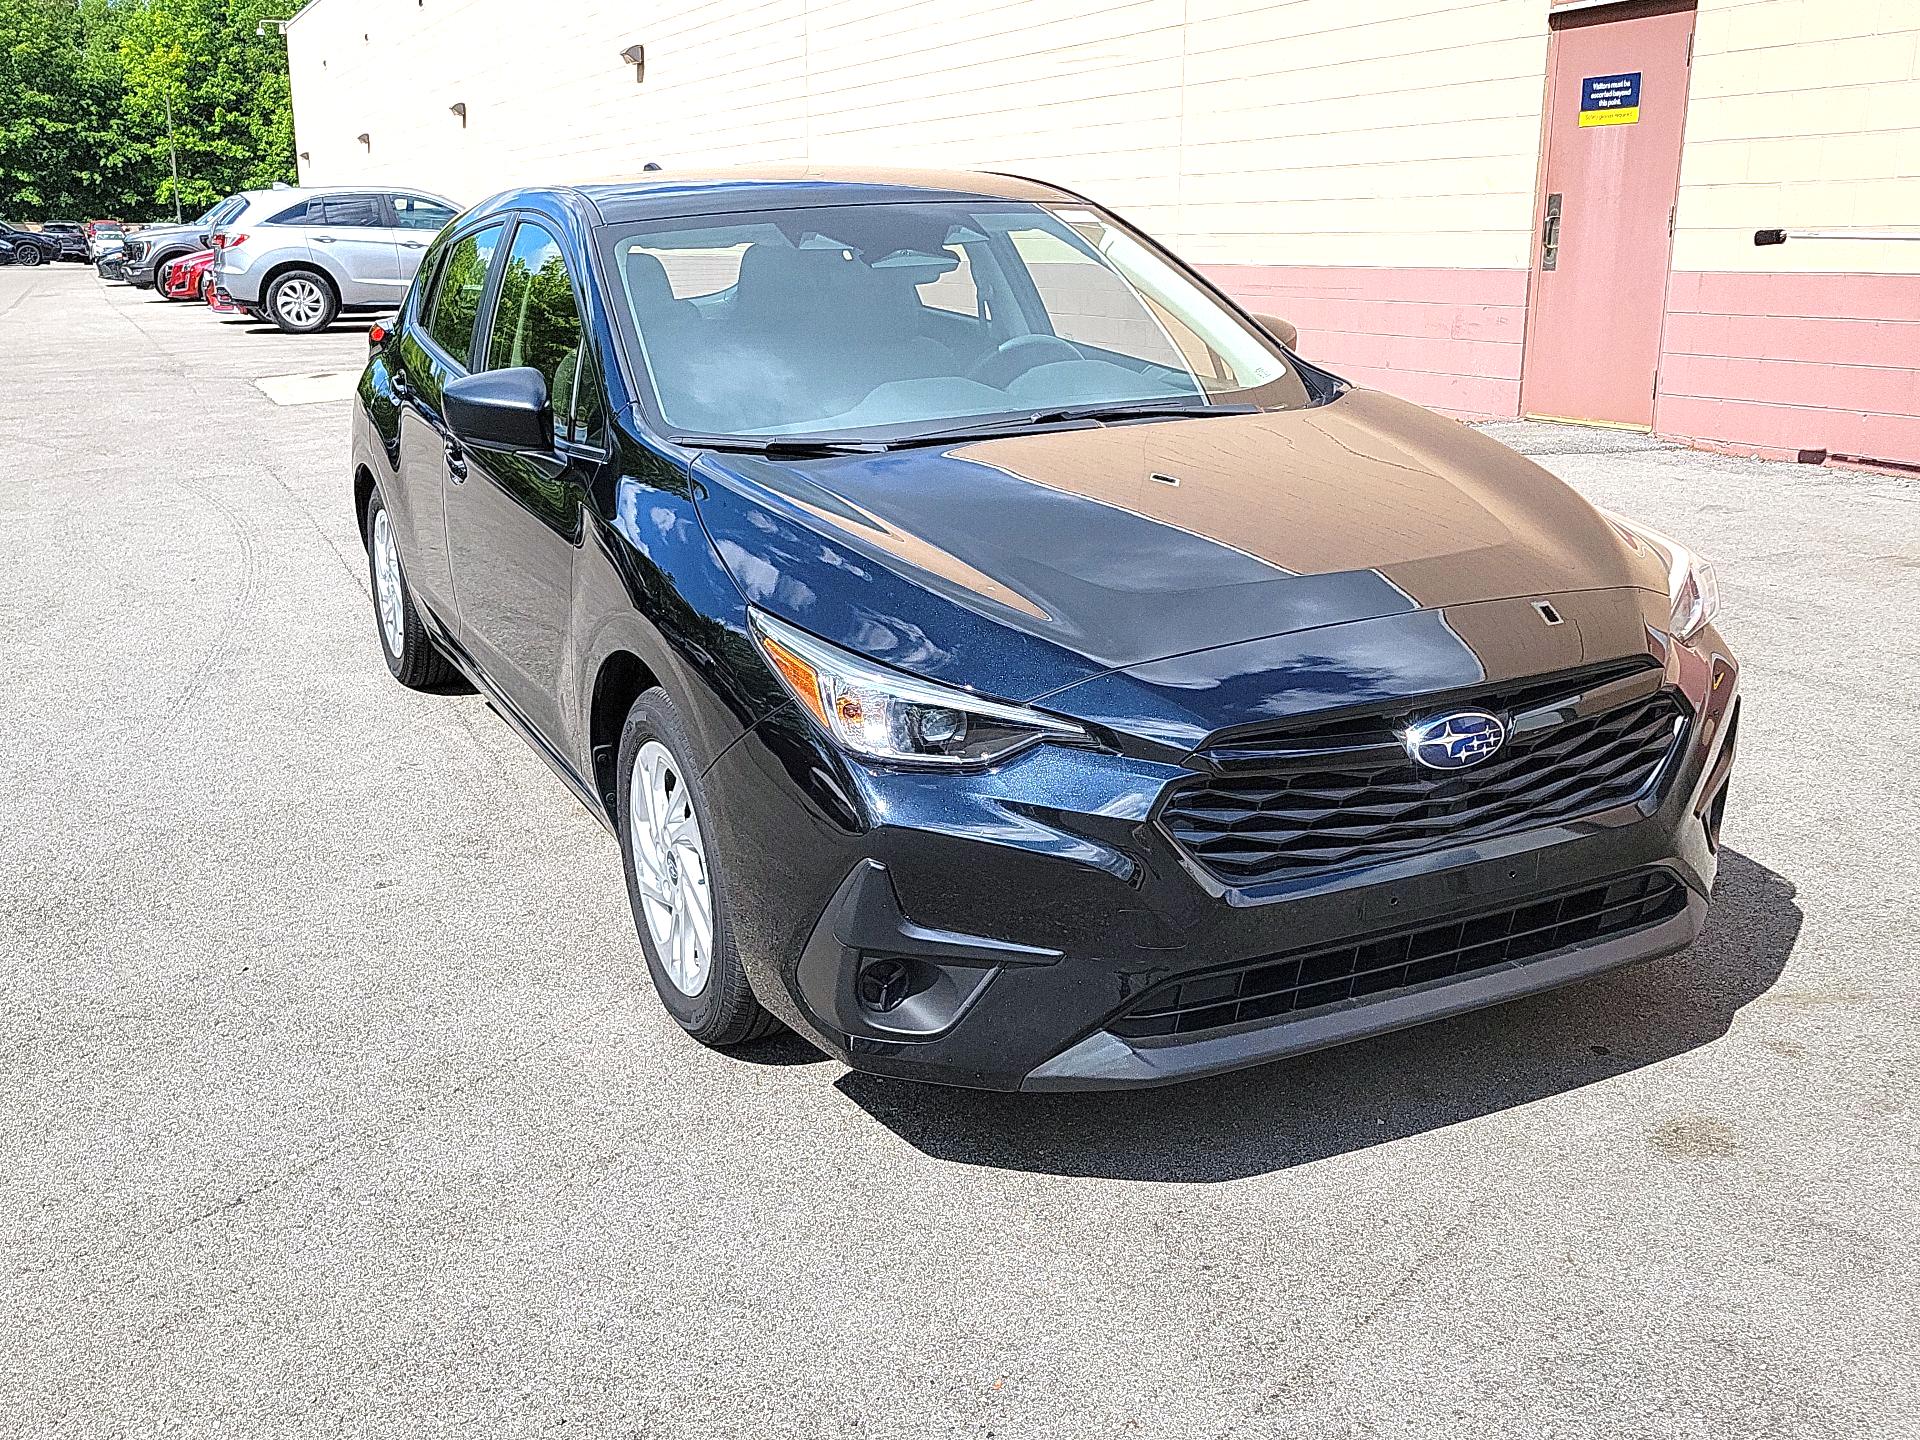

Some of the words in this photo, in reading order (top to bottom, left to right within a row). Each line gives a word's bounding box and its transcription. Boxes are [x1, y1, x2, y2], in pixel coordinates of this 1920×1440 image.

[1593, 82, 1610, 90] Visitors
[1611, 80, 1623, 88] must
[1624, 79, 1631, 87] be
[1590, 90, 1612, 99] escorted
[1613, 88, 1632, 98] beyond
[1598, 99, 1607, 107] this
